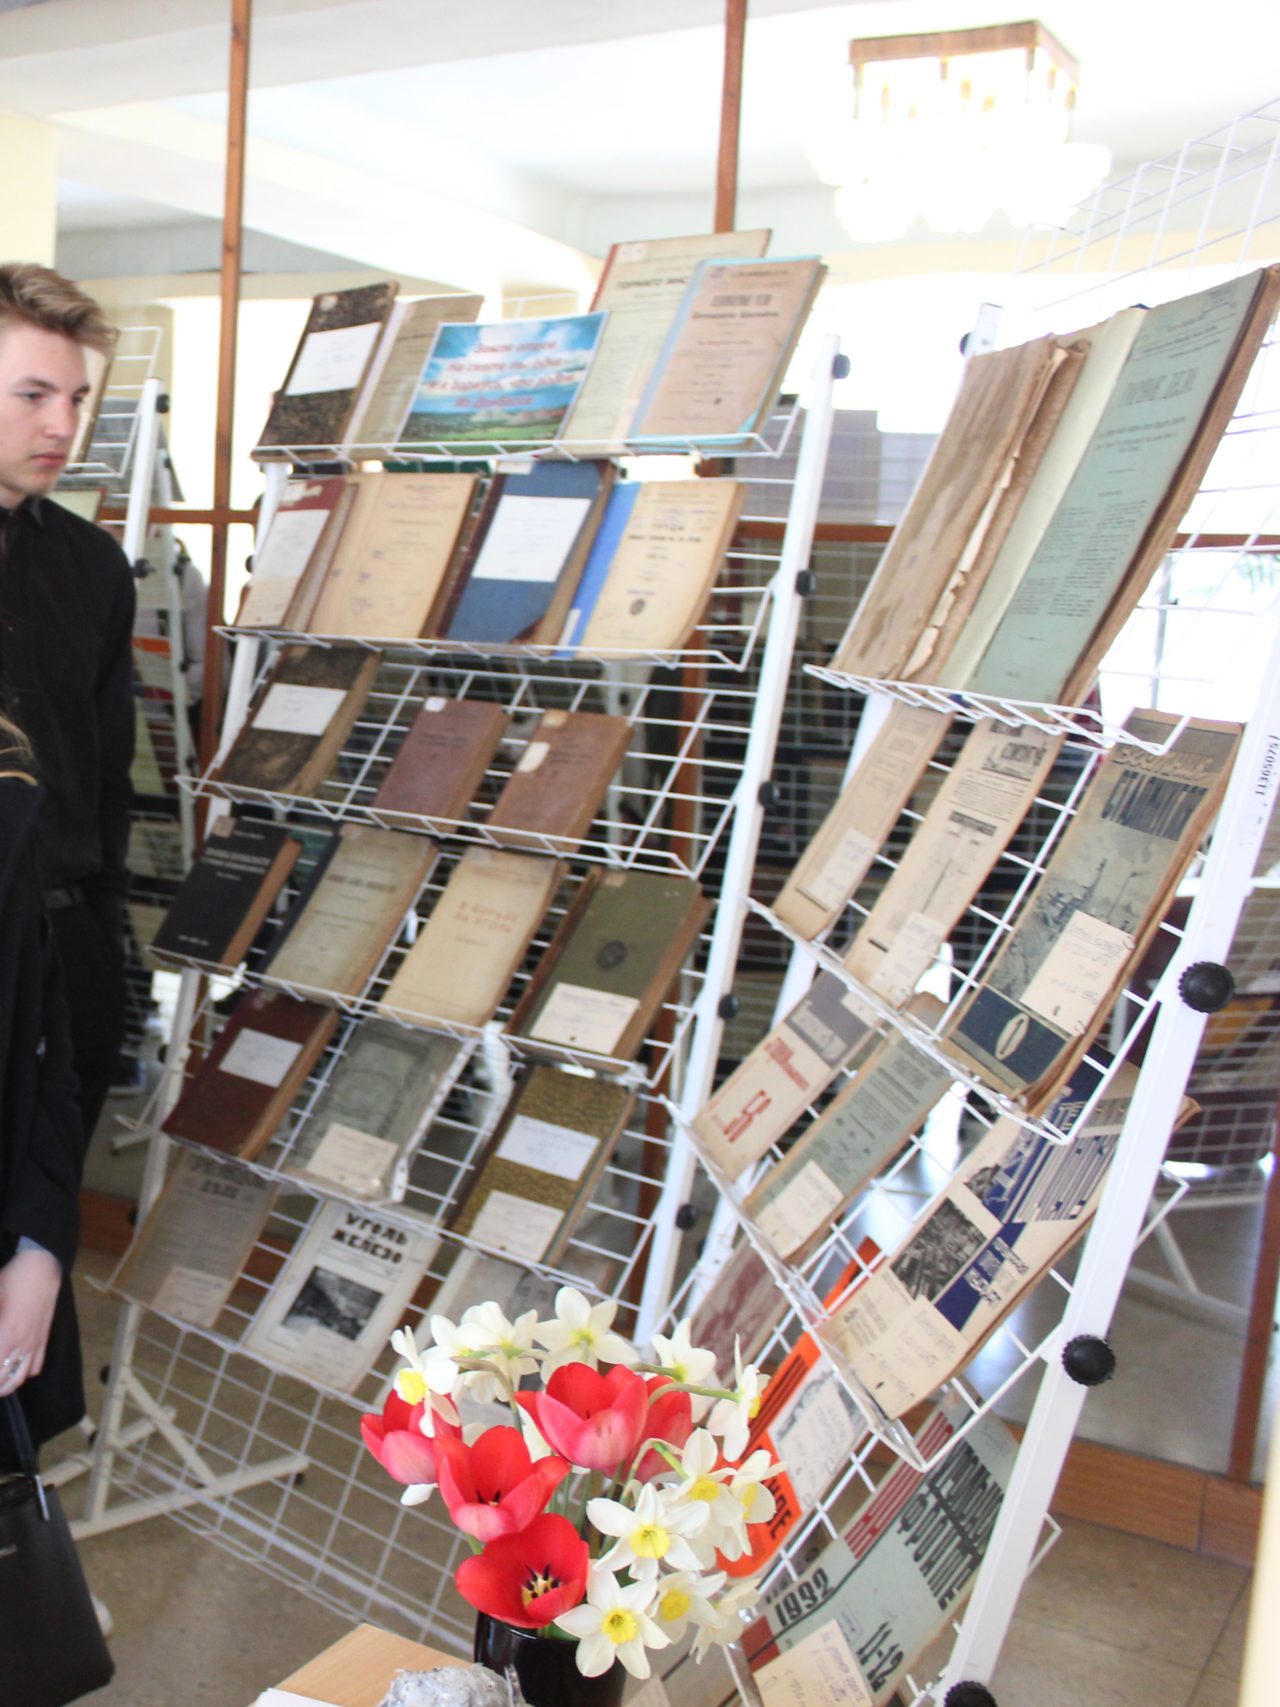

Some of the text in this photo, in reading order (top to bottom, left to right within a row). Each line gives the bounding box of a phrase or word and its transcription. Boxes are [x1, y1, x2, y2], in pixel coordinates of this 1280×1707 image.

[331, 1228, 403, 1264] ЖЕЛЕЗО
[346, 1212, 408, 1246] УГОЛЬ
[856, 1621, 904, 1694] 11-12
